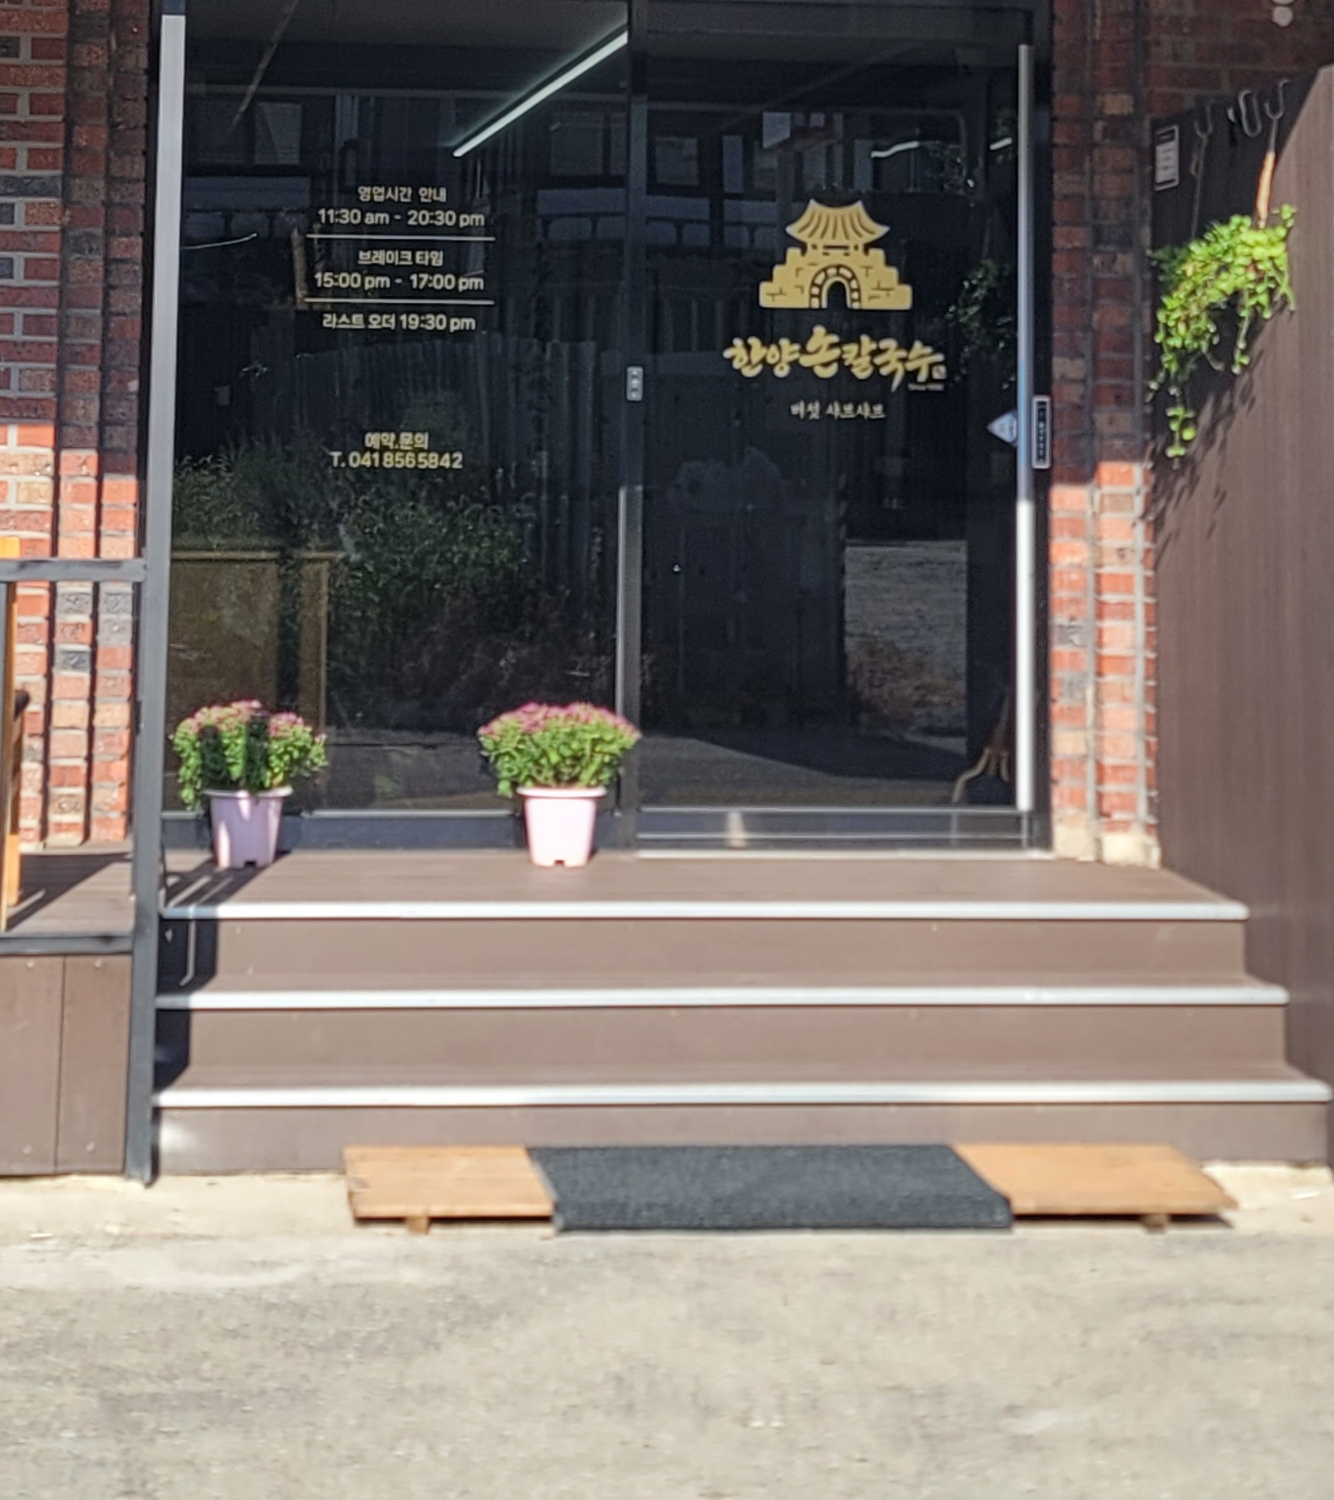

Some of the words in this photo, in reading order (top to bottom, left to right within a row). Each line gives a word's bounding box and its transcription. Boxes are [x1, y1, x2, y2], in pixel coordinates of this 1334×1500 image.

[357, 185, 413, 203] 영업시간
[418, 186, 447, 203] 안내
[318, 208, 362, 225] 11:30
[364, 212, 390, 225] am
[407, 209, 457, 227] 20:30
[459, 213, 486, 229] pm
[357, 250, 414, 266] 브레이크
[415, 250, 444, 267] 타임
[314, 271, 362, 289] 15:00
[364, 276, 391, 291] pm
[409, 273, 456, 290] 17:00
[458, 277, 485, 293] pm
[322, 313, 366, 330] 라스트
[368, 313, 396, 330] 오더
[399, 313, 448, 331] 19:30
[449, 316, 477, 333] pm
